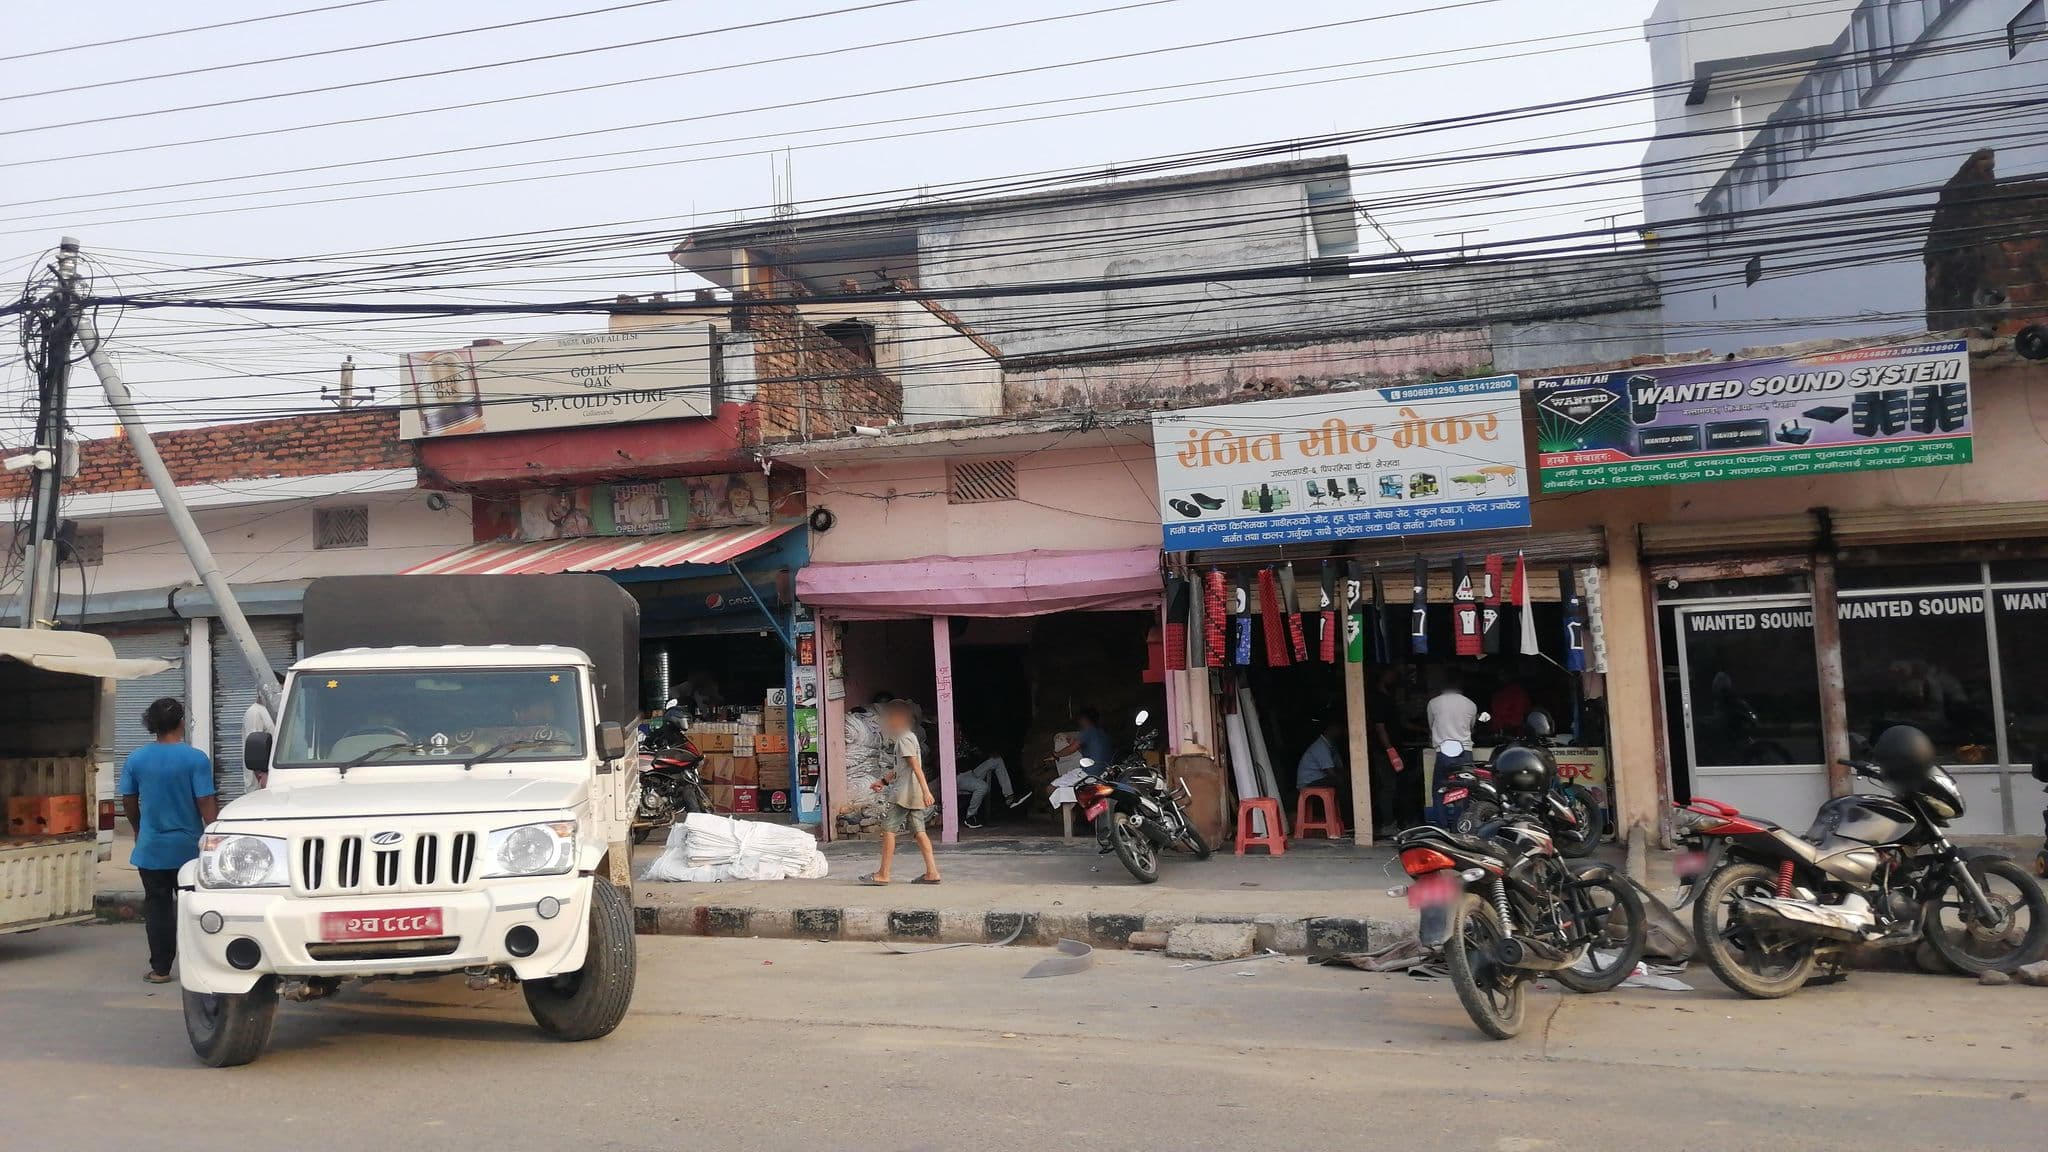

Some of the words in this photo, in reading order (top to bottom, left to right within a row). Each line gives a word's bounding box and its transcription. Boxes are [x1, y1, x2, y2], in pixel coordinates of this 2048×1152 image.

[581, 337, 604, 345] ABOVE
[605, 335, 619, 343] ALL
[622, 333, 638, 341] ELSE
[571, 363, 625, 378] GOLDEN
[583, 376, 612, 388] OAK
[1538, 381, 1560, 389] Pro.
[1562, 376, 1592, 387] Akhil
[1593, 375, 1609, 385] Ali
[1637, 379, 1743, 406] WANTED
[1747, 370, 1844, 397] SOUND
[1848, 359, 1960, 388] SYSTEM
[436, 389, 458, 399] OAK
[1550, 394, 1609, 407] WANTED
[531, 400, 558, 413] S.P.
[562, 395, 607, 410] COLD
[612, 390, 667, 406] STORE
[1175, 428, 1284, 468] रंजित
[1299, 417, 1378, 458] सीट
[1391, 406, 1499, 449] मेकर
[1671, 435, 1694, 443] SOUND
[1705, 469, 1723, 477] DJ
[1838, 600, 1913, 620] WANTED
[1919, 596, 1984, 616] SOUND
[1691, 614, 1755, 632] WANTED
[1760, 611, 1815, 630] SOUND
[1555, 763, 1594, 780] कर
